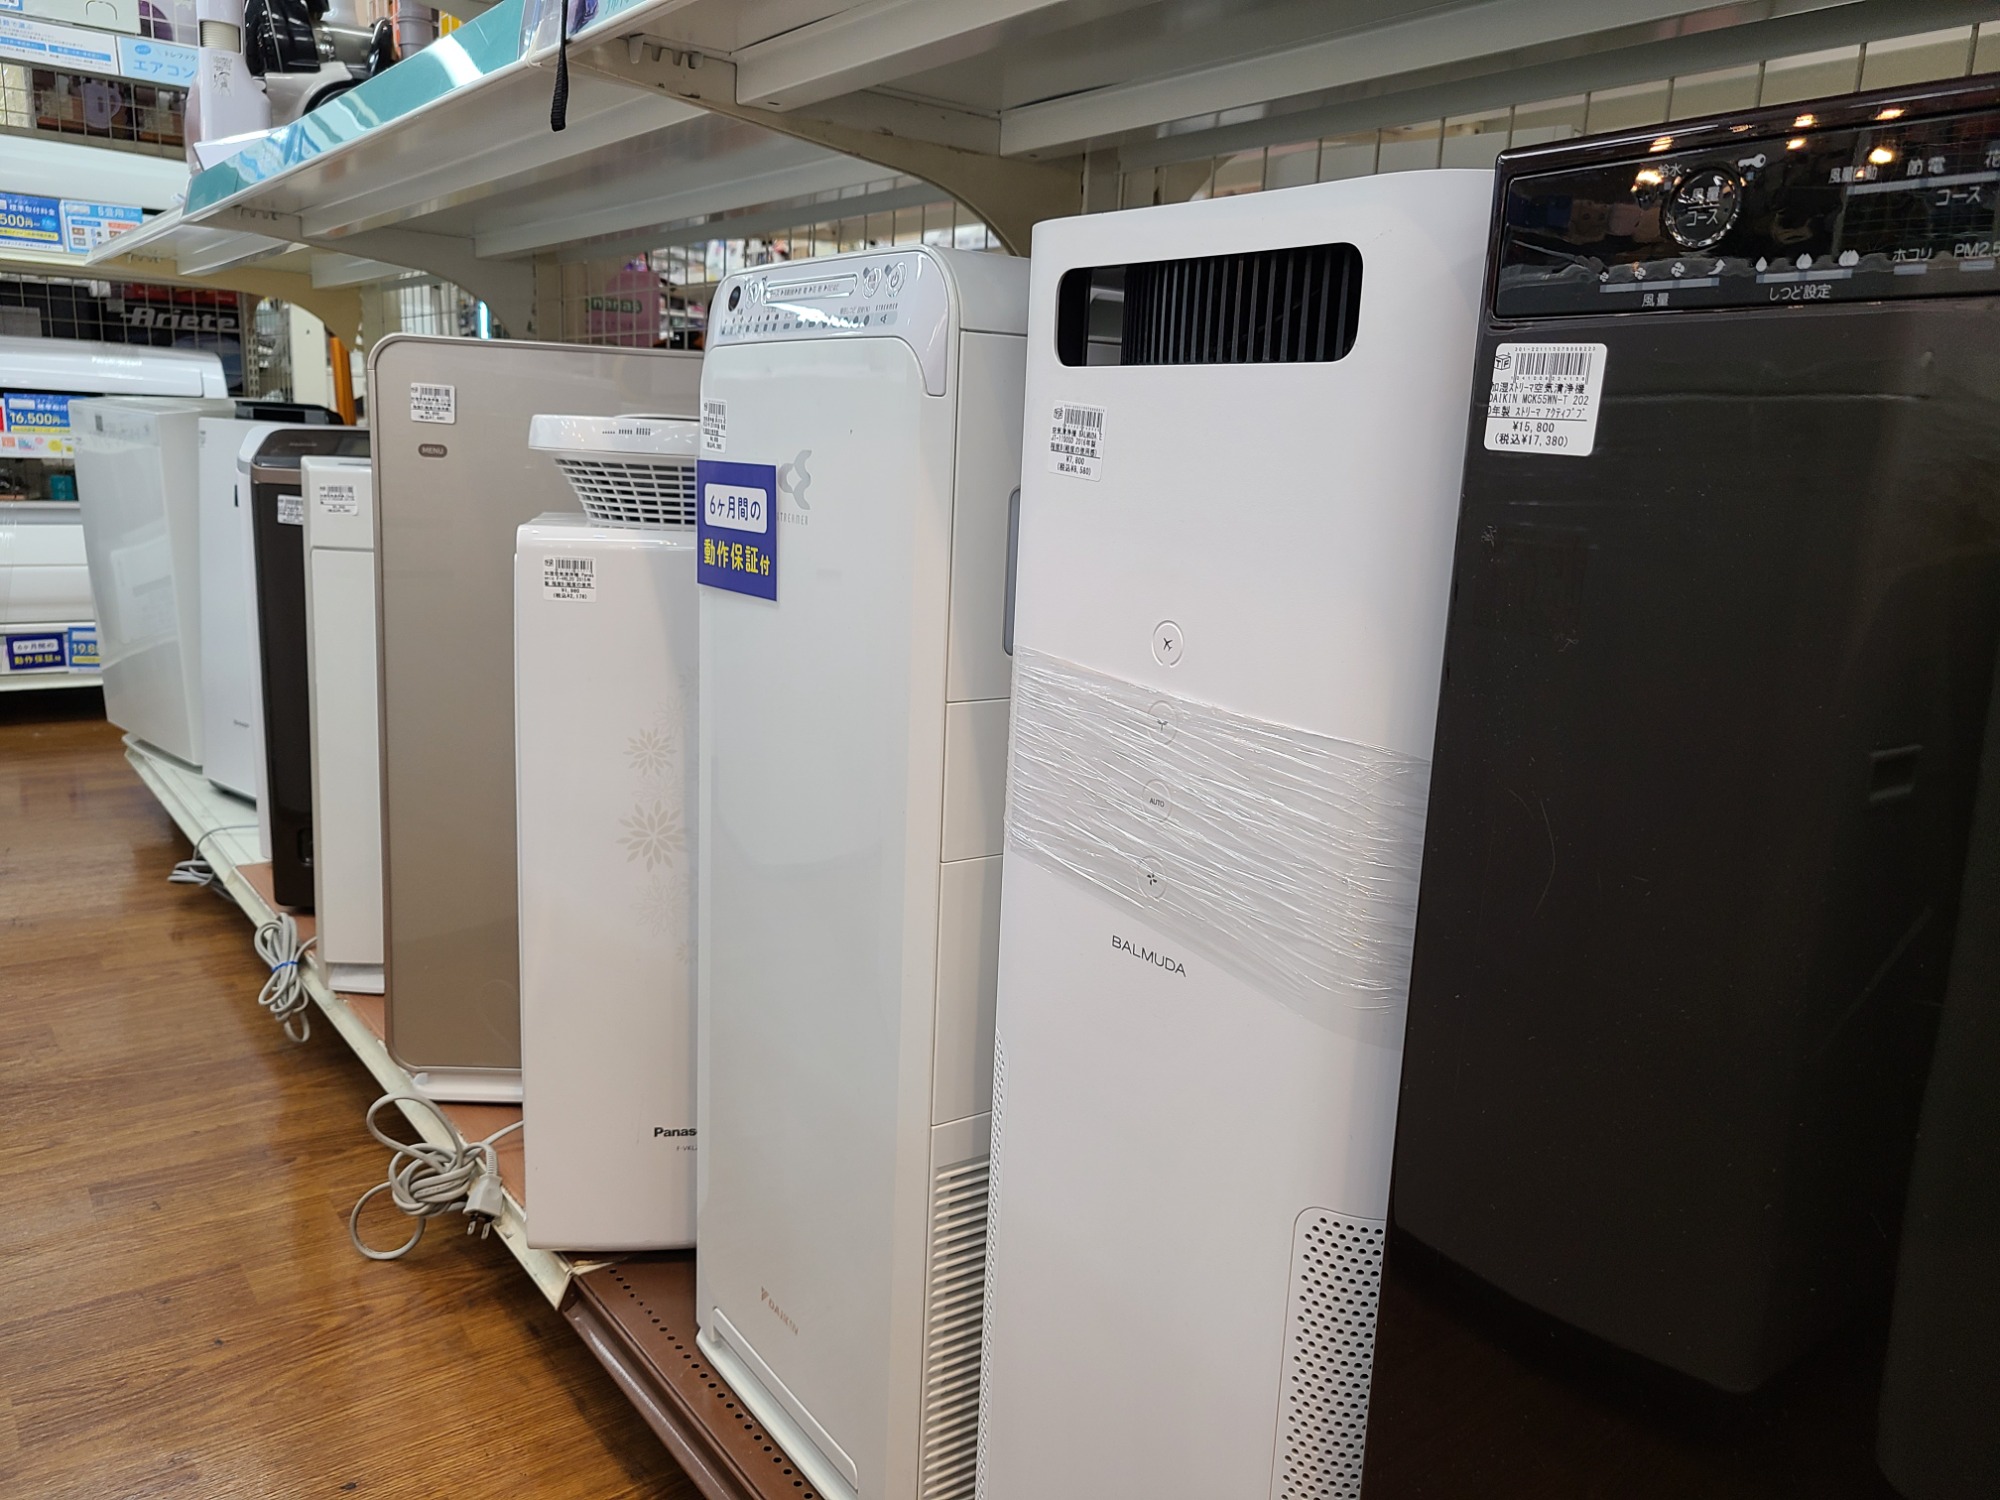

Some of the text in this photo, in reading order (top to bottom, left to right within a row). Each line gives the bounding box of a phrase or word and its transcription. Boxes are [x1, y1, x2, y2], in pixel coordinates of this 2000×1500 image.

[134, 59, 195, 79] エアコン
[1936, 186, 1981, 207] コース
[1686, 208, 1719, 227] コース
[1953, 242, 2000, 259] PM2.5
[1641, 292, 1670, 308] 風量
[1769, 284, 1832, 302] しつど設定
[1489, 394, 1518, 404] DAIKIN
[1573, 395, 1589, 406] 202
[1513, 421, 1555, 433] ¥15,800
[1494, 433, 1569, 448] (税込¥17,380)
[710, 495, 761, 522] 6ヶ月間の
[703, 538, 770, 576] 動作保証付
[1149, 797, 1165, 808] AUTO
[1111, 935, 1187, 978] BALMUDA
[654, 1126, 698, 1138] Panas
